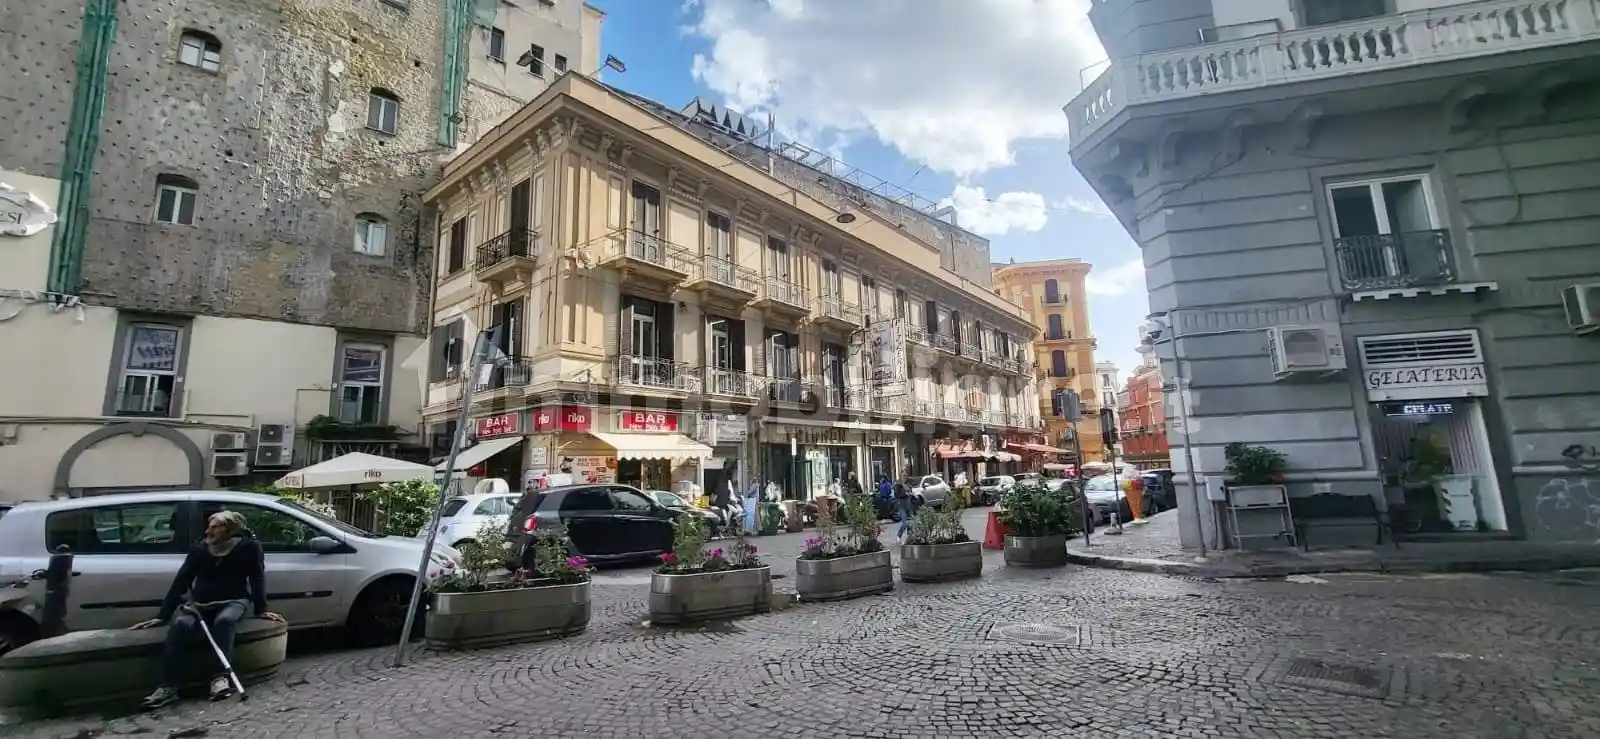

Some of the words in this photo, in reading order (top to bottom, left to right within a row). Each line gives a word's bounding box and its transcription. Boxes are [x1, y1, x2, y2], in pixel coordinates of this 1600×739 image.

[1369, 366, 1484, 389] GELATERIA
[486, 415, 509, 428] BAR
[567, 413, 585, 424] riko
[634, 412, 666, 424] BAR
[364, 468, 382, 478] riko
